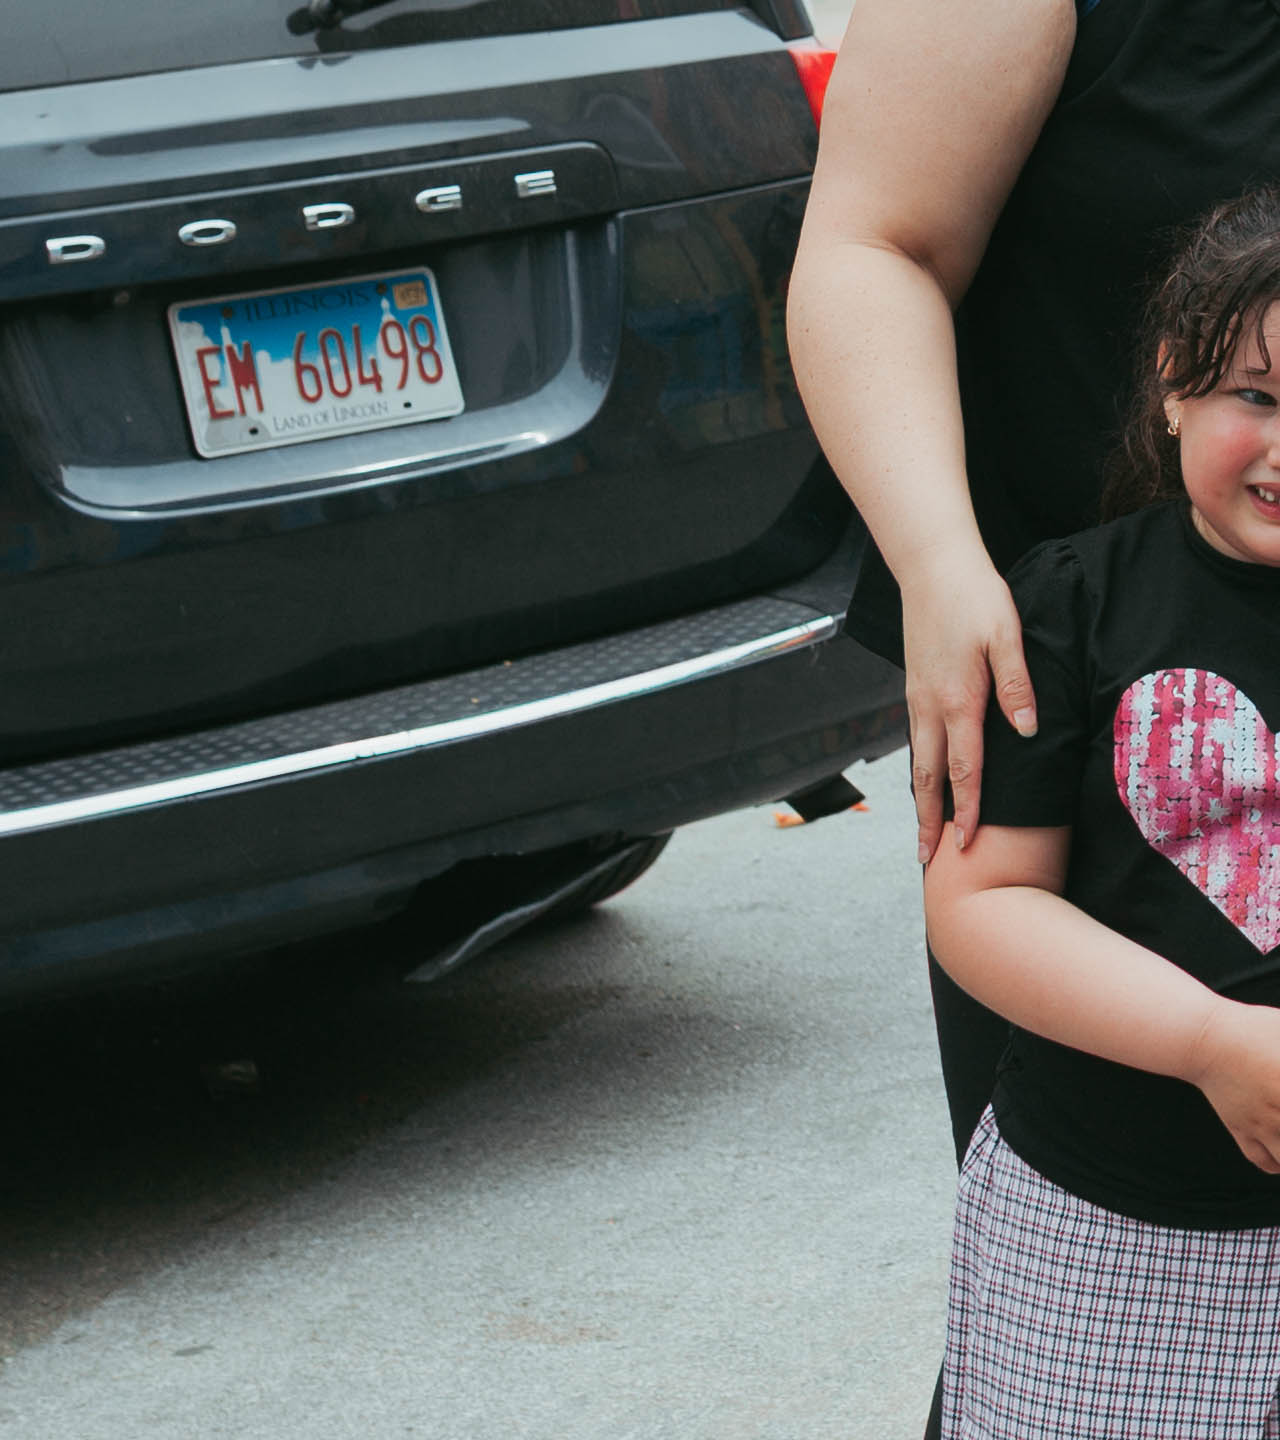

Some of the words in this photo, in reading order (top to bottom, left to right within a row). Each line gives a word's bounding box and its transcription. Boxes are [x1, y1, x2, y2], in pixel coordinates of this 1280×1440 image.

[46, 170, 557, 264] DODGE
[243, 290, 371, 321] ILLINOIS
[197, 341, 264, 420] EM
[294, 314, 443, 404] 60498
